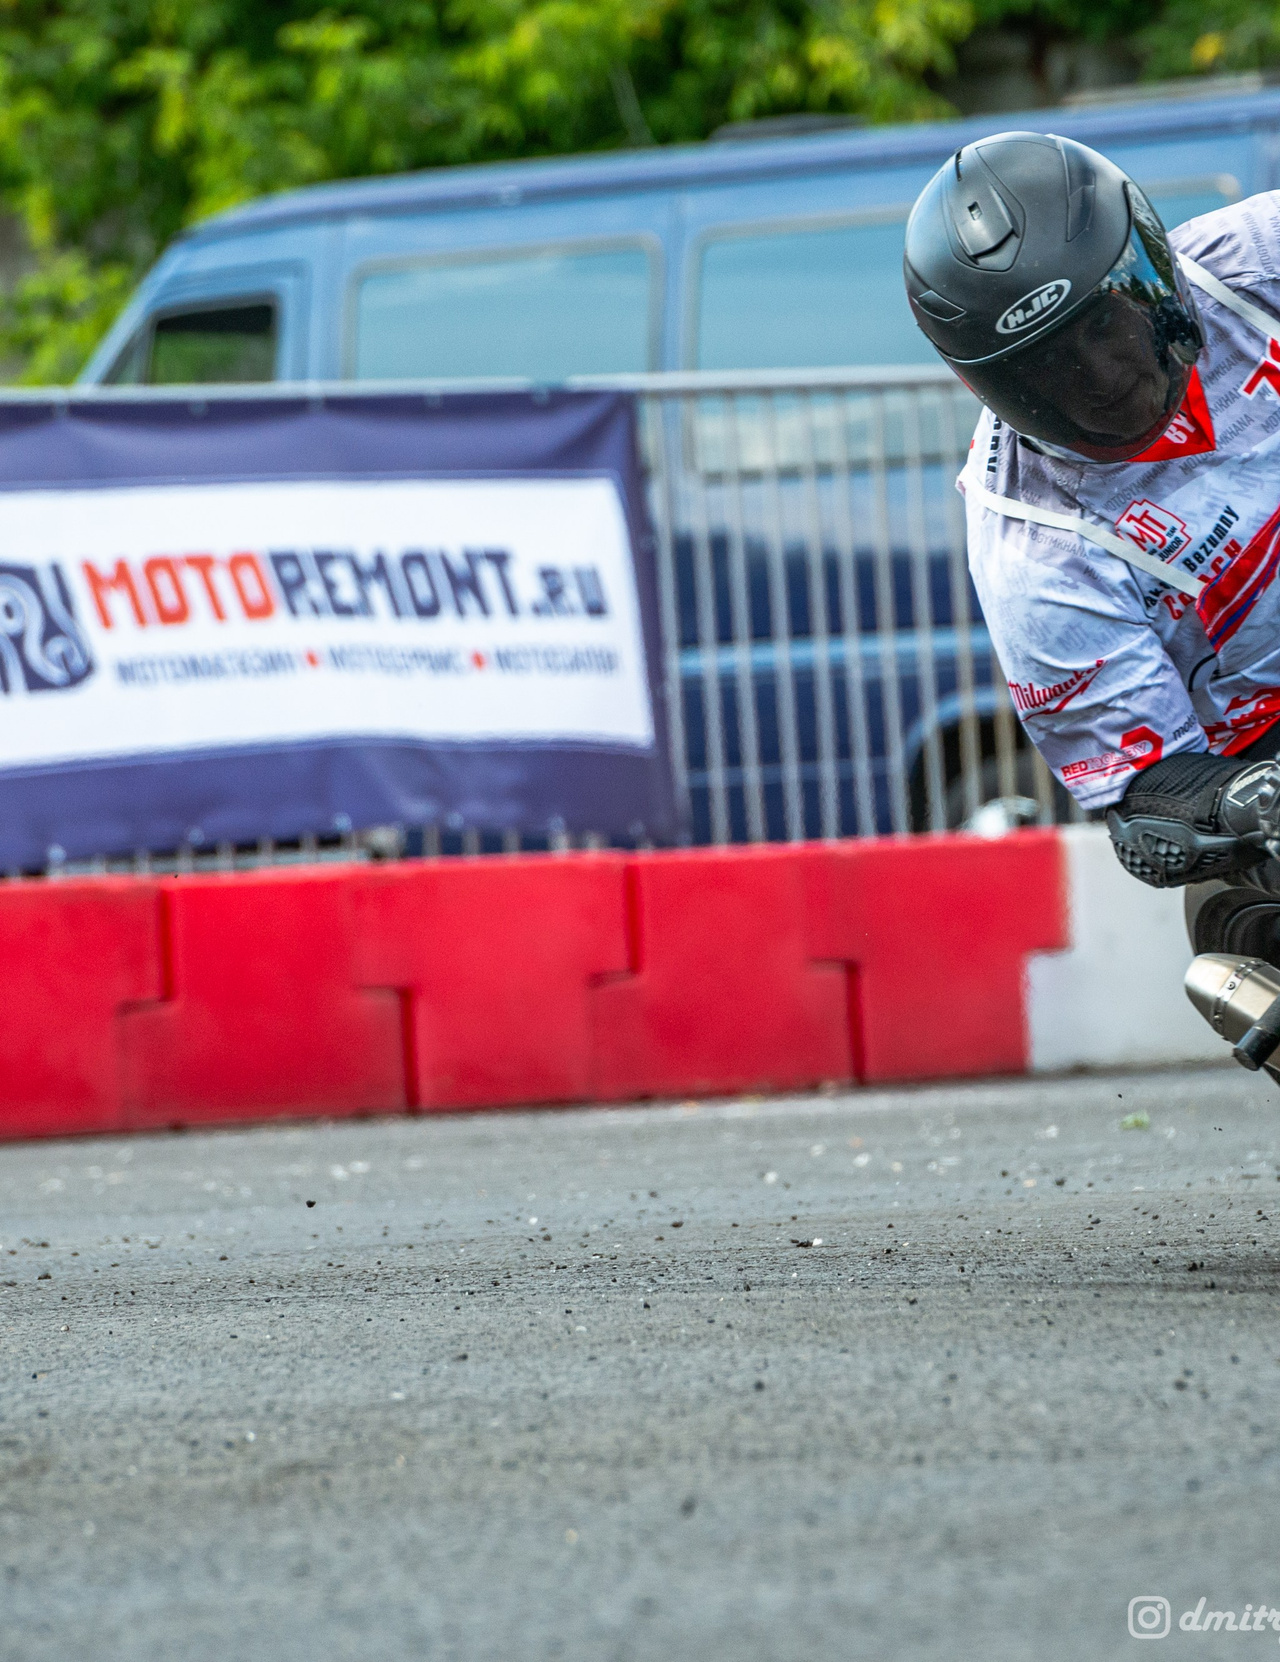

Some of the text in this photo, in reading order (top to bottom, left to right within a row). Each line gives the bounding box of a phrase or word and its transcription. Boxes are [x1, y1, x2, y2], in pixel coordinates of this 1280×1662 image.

[1006, 284, 1059, 329] HJC
[1126, 509, 1167, 552] MJT
[1182, 505, 1240, 573] Bezumny
[83, 548, 607, 630] MOTOREMONT.RU
